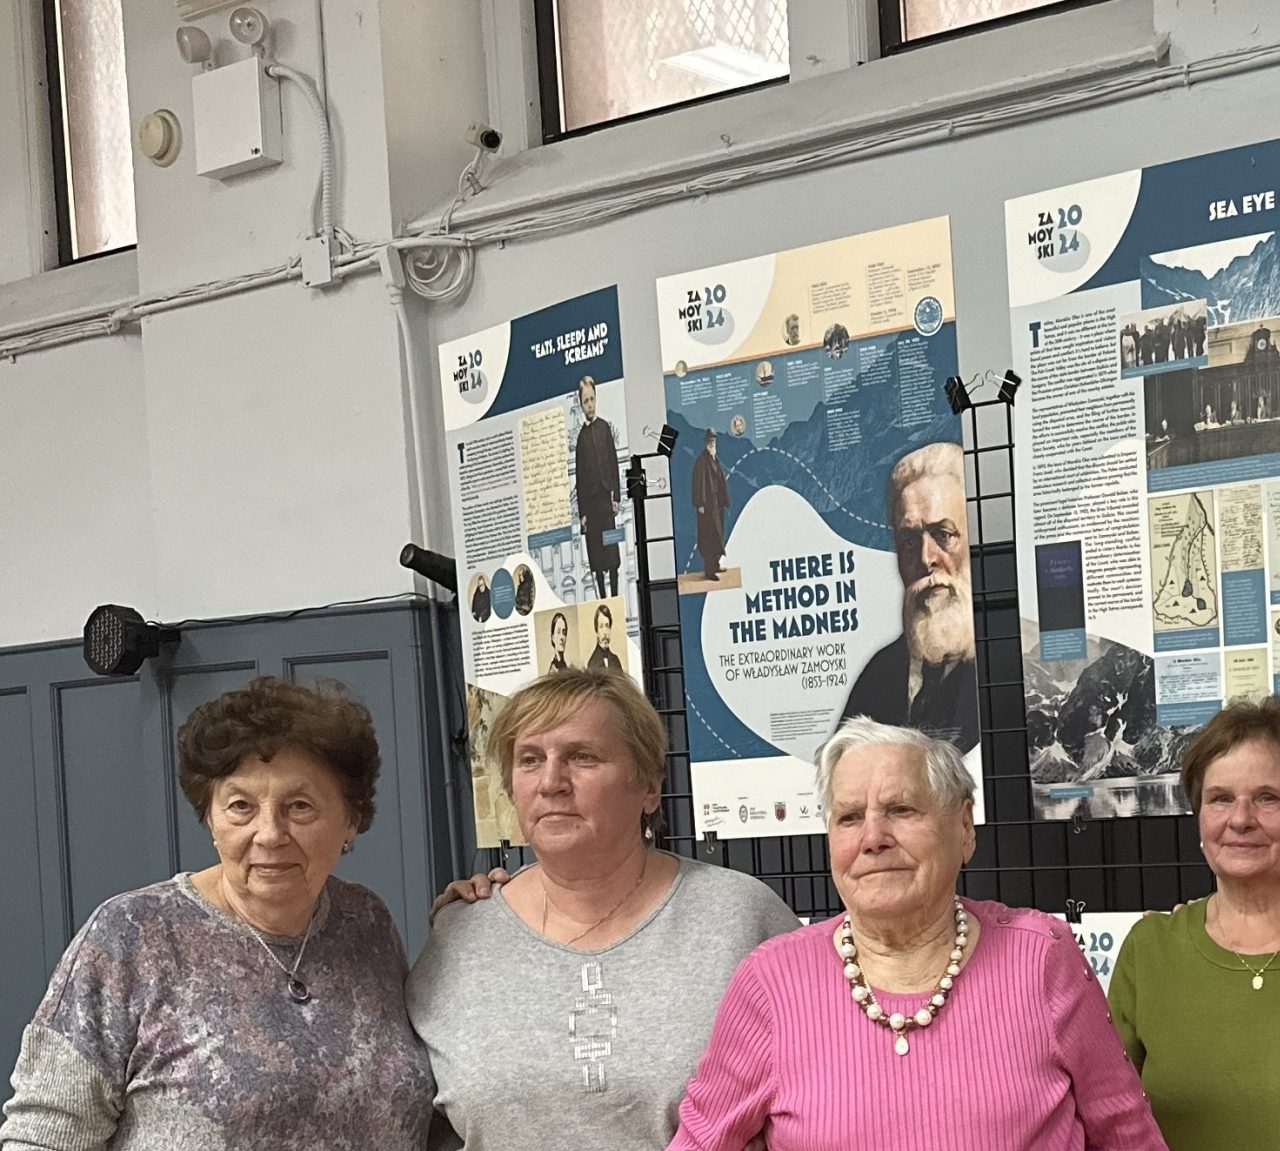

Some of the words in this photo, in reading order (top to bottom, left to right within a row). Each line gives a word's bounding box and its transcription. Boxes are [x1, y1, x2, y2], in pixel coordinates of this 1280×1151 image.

[1058, 204, 1083, 229] 20
[1209, 199, 1239, 221] SEA
[1242, 190, 1275, 214] EYE
[1038, 211, 1054, 227] ZA
[1028, 226, 1054, 246] MOY
[1059, 230, 1080, 255] 24
[1037, 243, 1054, 260] SKI
[687, 289, 701, 303] ZA
[705, 284, 726, 306] 20
[678, 303, 701, 320] MOY
[706, 307, 725, 328] 24
[688, 318, 703, 333] SKI
[556, 328, 586, 352] SLEEPS
[587, 322, 608, 343] AND
[769, 553, 833, 583] THERE
[839, 550, 855, 574] IS
[745, 583, 829, 614] METHOD
[836, 579, 856, 603] IN
[729, 618, 766, 643] THE
[772, 608, 859, 639] MADNESS
[720, 655, 736, 667] THE
[738, 646, 814, 665] EXTRAORDINARY
[816, 643, 846, 656] WORK
[725, 668, 740, 681] OF
[801, 659, 847, 674] ZAMOYSKI
[1090, 932, 1114, 952] 20
